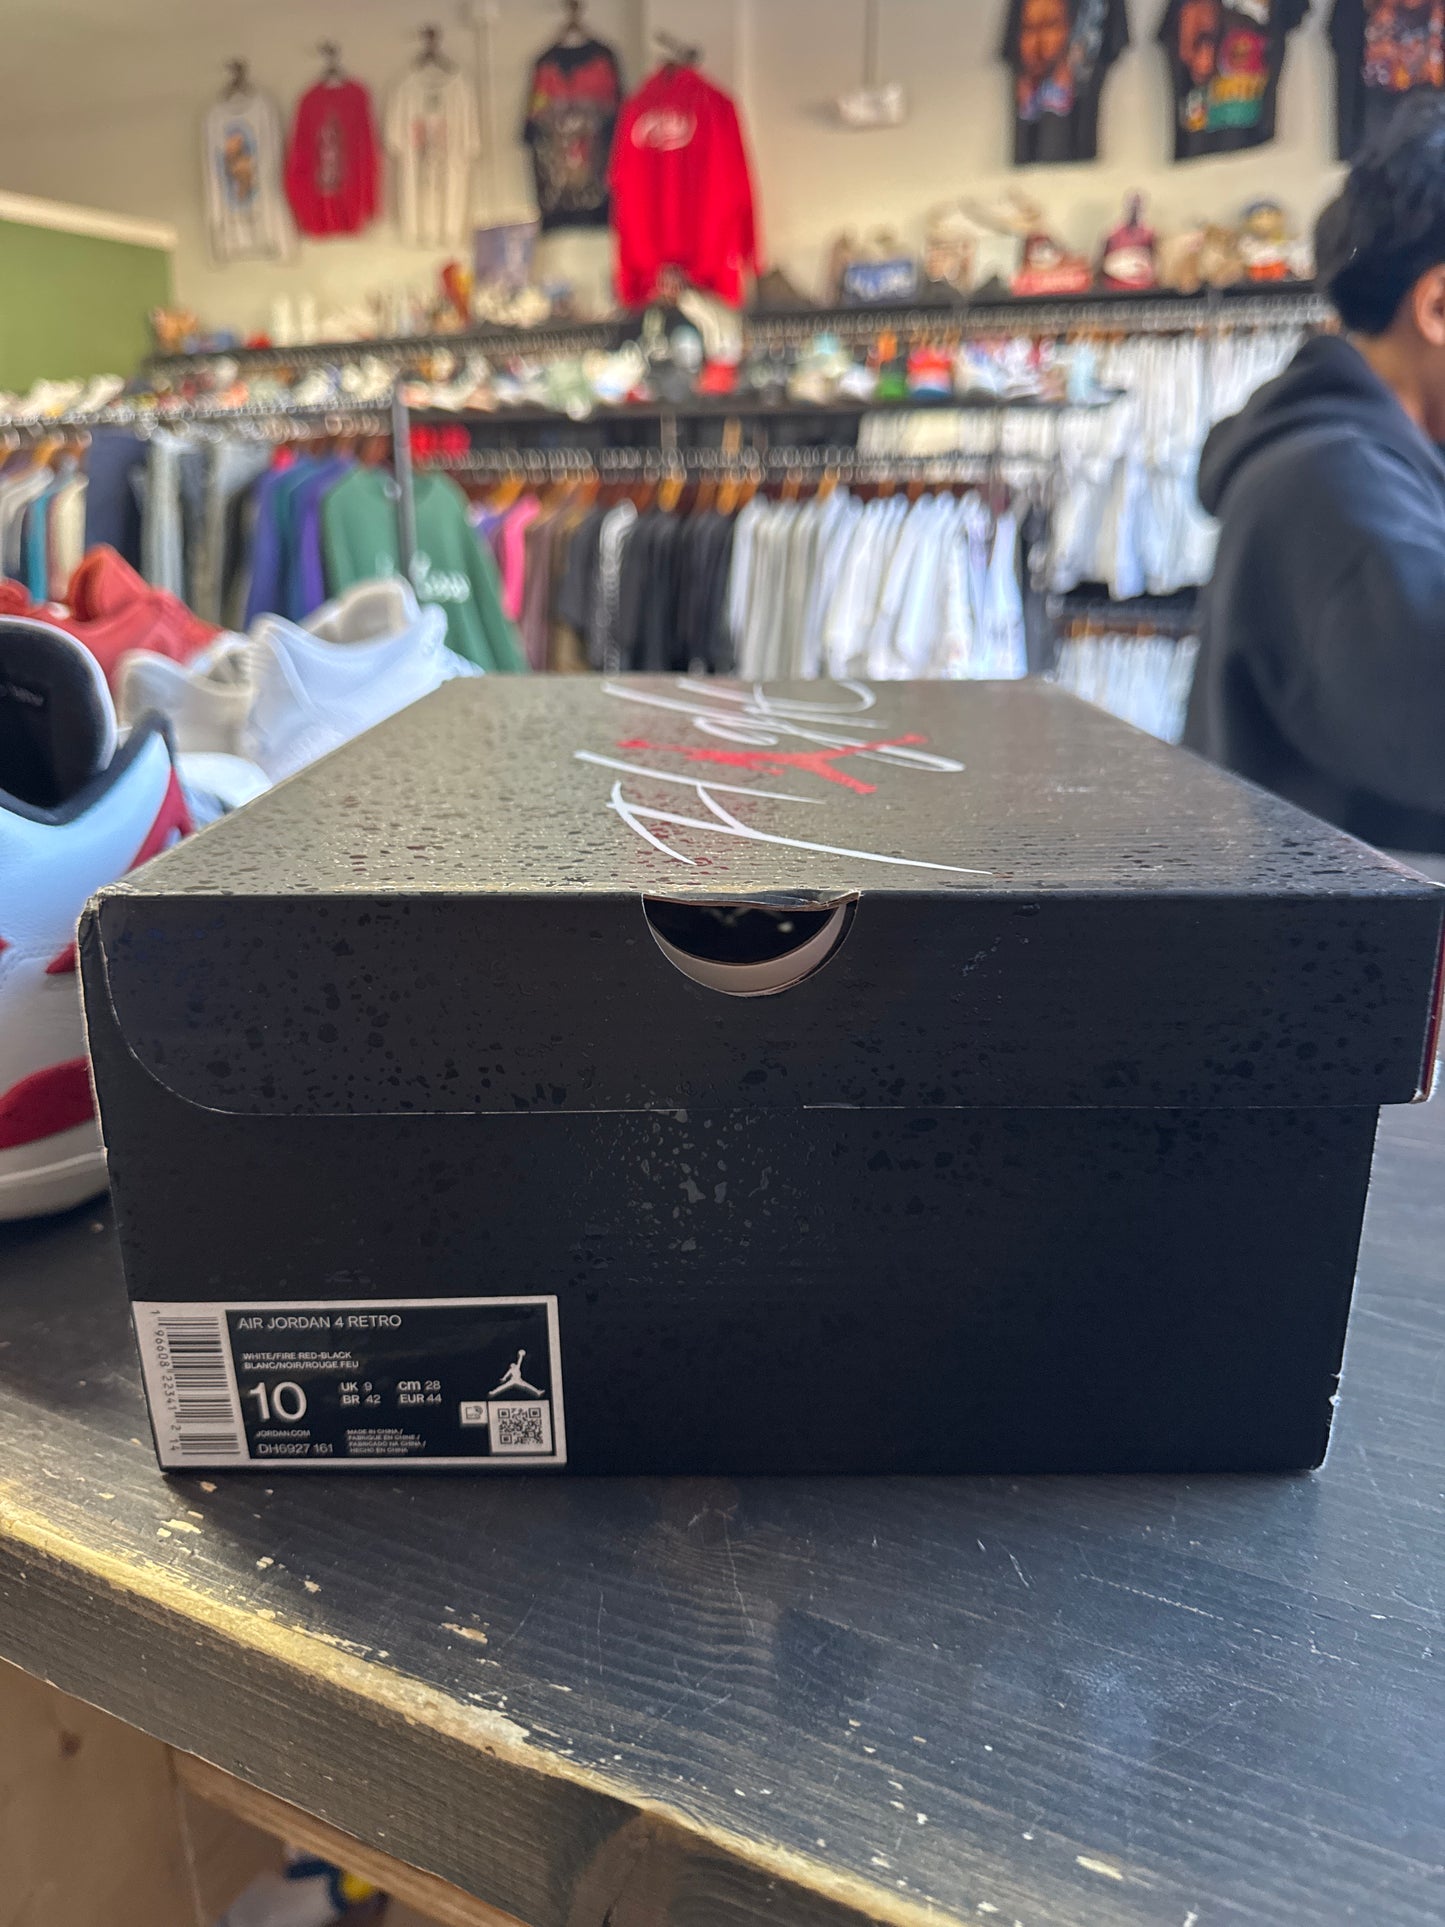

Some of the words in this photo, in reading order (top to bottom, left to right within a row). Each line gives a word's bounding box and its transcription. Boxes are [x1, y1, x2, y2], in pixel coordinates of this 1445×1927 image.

[238, 1317, 264, 1330] AIR
[267, 1316, 331, 1330] JORDAN
[334, 1316, 345, 1329] 4
[348, 1315, 402, 1328] RETRO
[243, 1352, 297, 1361] WHITE/FIRE
[299, 1351, 352, 1360] RED-BLACK
[244, 1361, 339, 1370] BLANC/NOIR/ROUGE
[341, 1360, 359, 1369] FEU
[154, 1330, 170, 1368] 96608
[162, 1375, 178, 1411] 22341
[341, 1382, 359, 1392] UK
[364, 1382, 373, 1392] 9
[399, 1381, 421, 1391] cm
[425, 1381, 441, 1391] 28
[249, 1381, 307, 1421] 10
[343, 1395, 360, 1404] BR
[366, 1394, 381, 1404] 42
[400, 1394, 425, 1404] EUR
[426, 1394, 442, 1404] 44
[256, 1429, 311, 1438] JORDAN.COM
[258, 1443, 310, 1455] DH6927
[313, 1443, 333, 1453] 161
